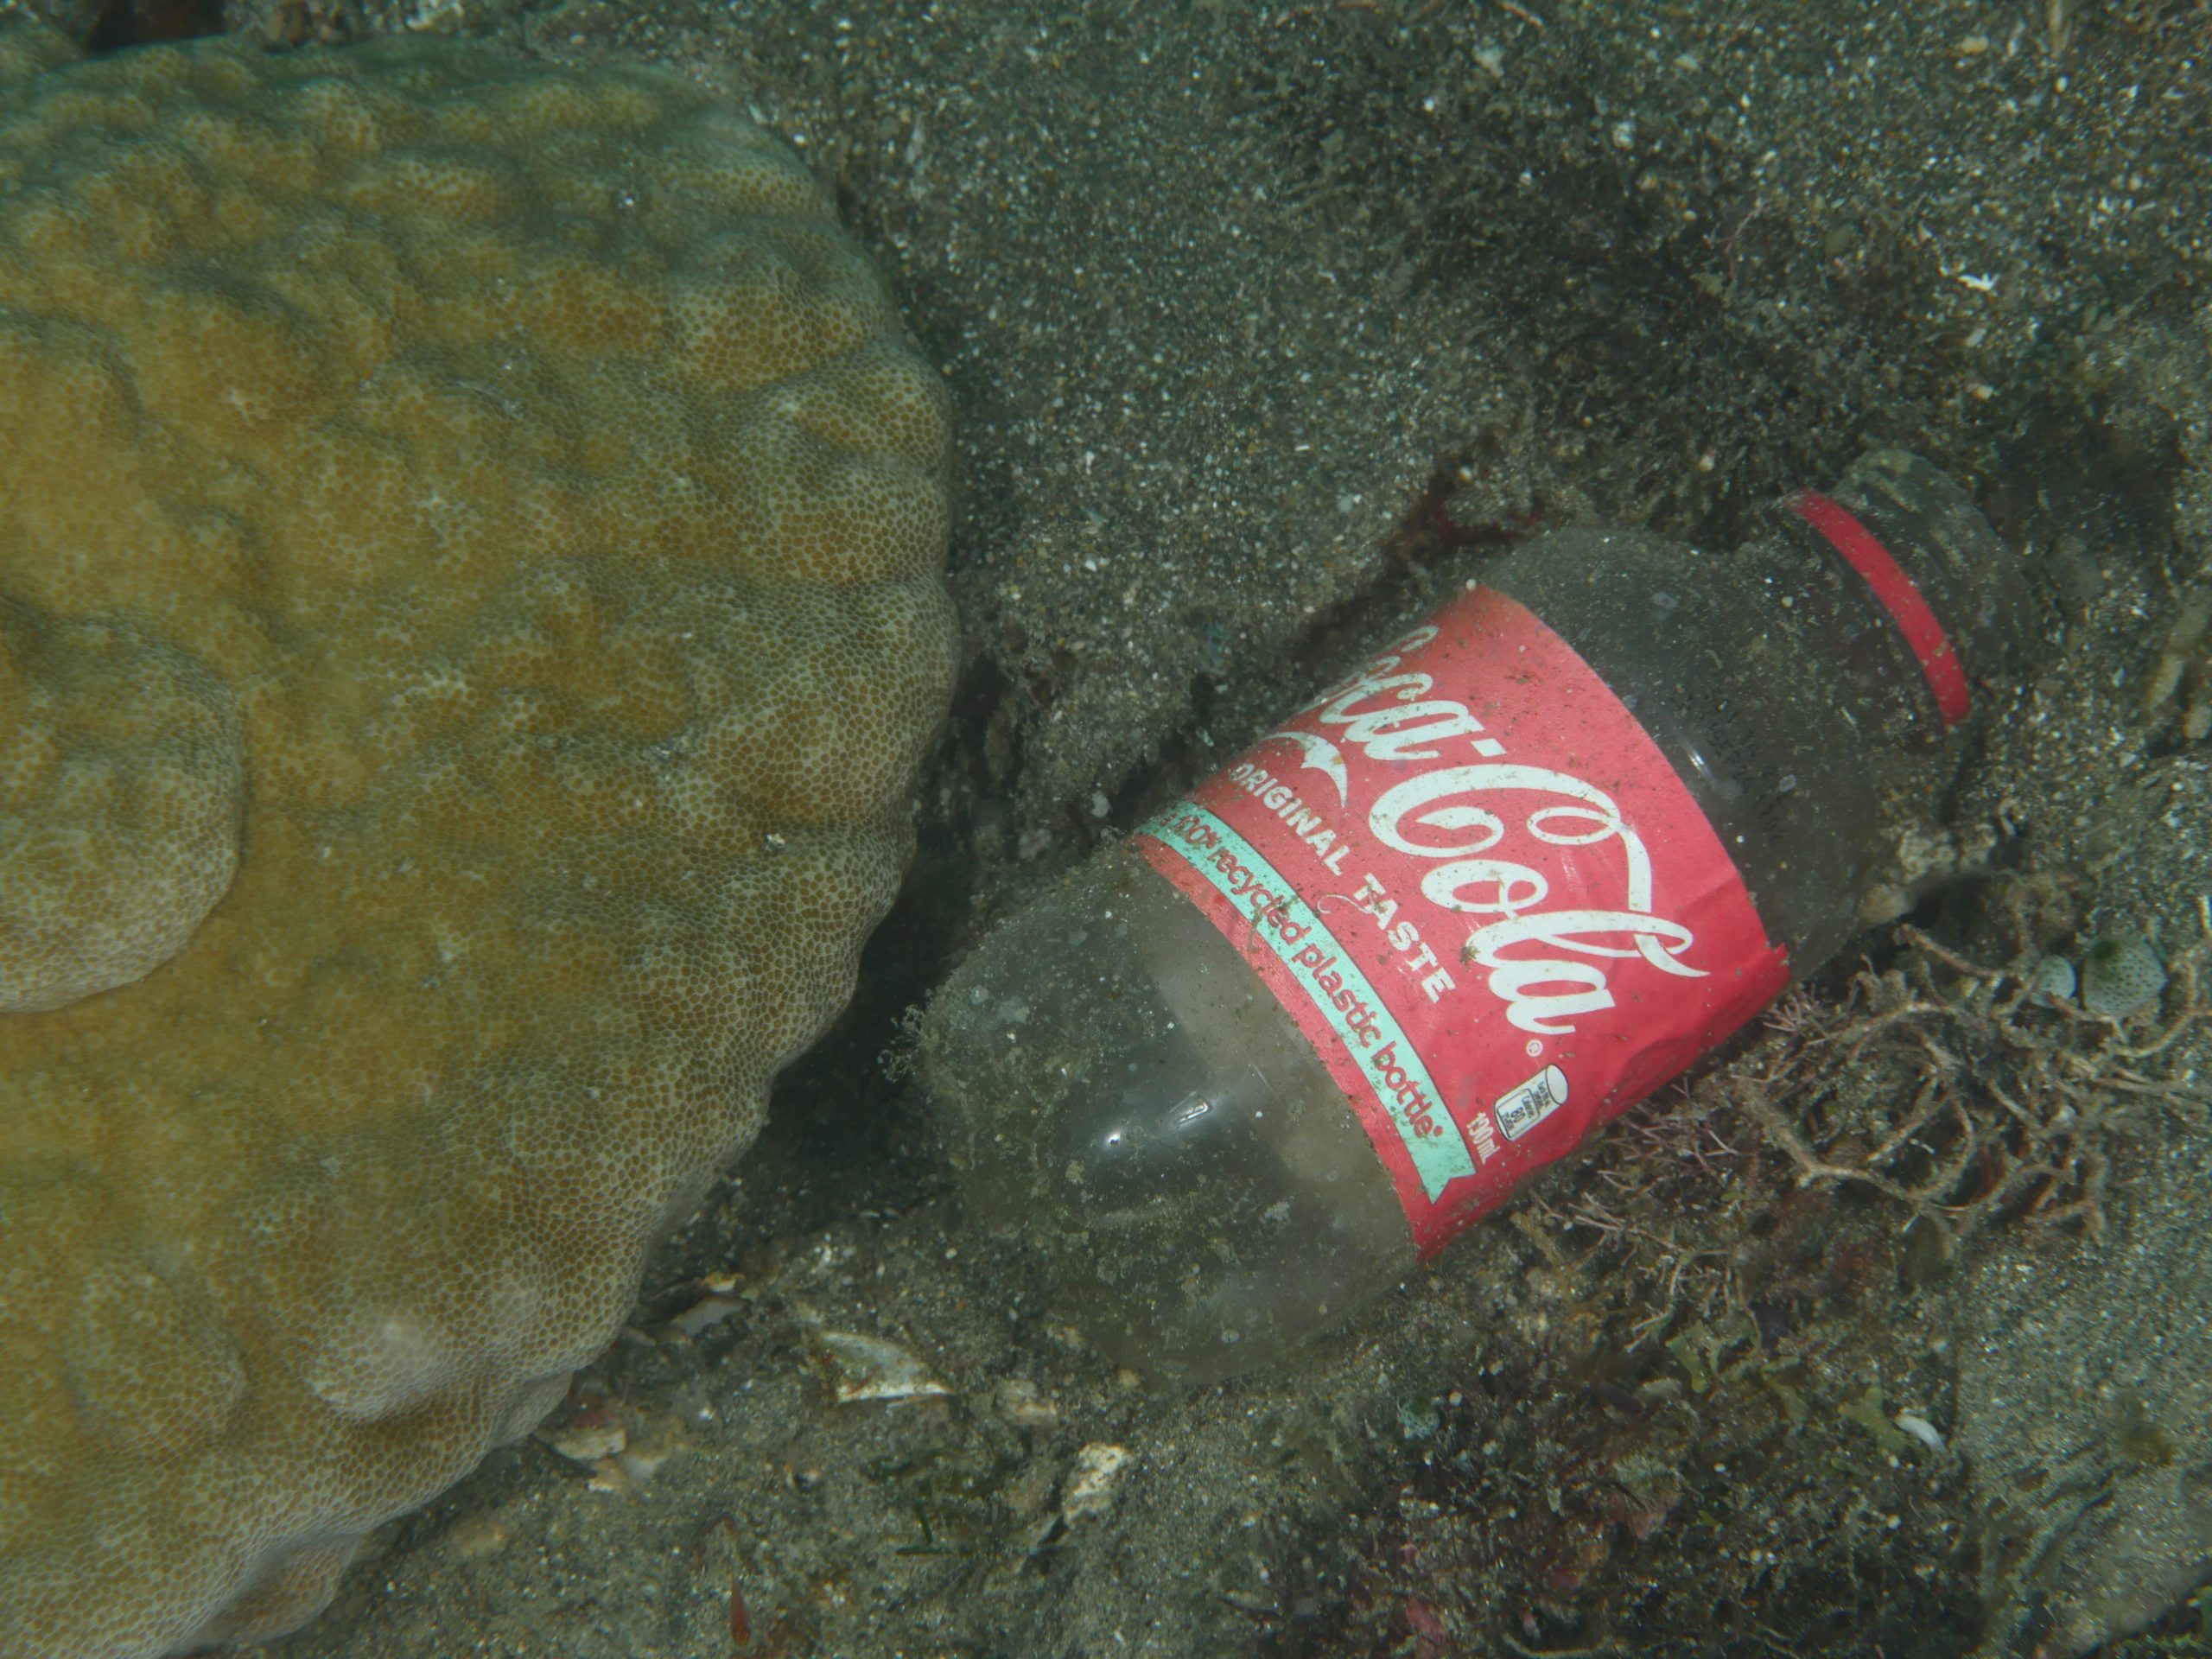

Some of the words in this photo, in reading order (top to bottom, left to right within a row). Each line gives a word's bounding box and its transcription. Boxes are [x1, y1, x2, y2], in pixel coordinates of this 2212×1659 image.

[1209, 847, 1312, 946] recycled
[1291, 943, 1382, 1048] plastic
[1230, 764, 1350, 876] ORIGINAL
[1353, 873, 1456, 1004] TASTE
